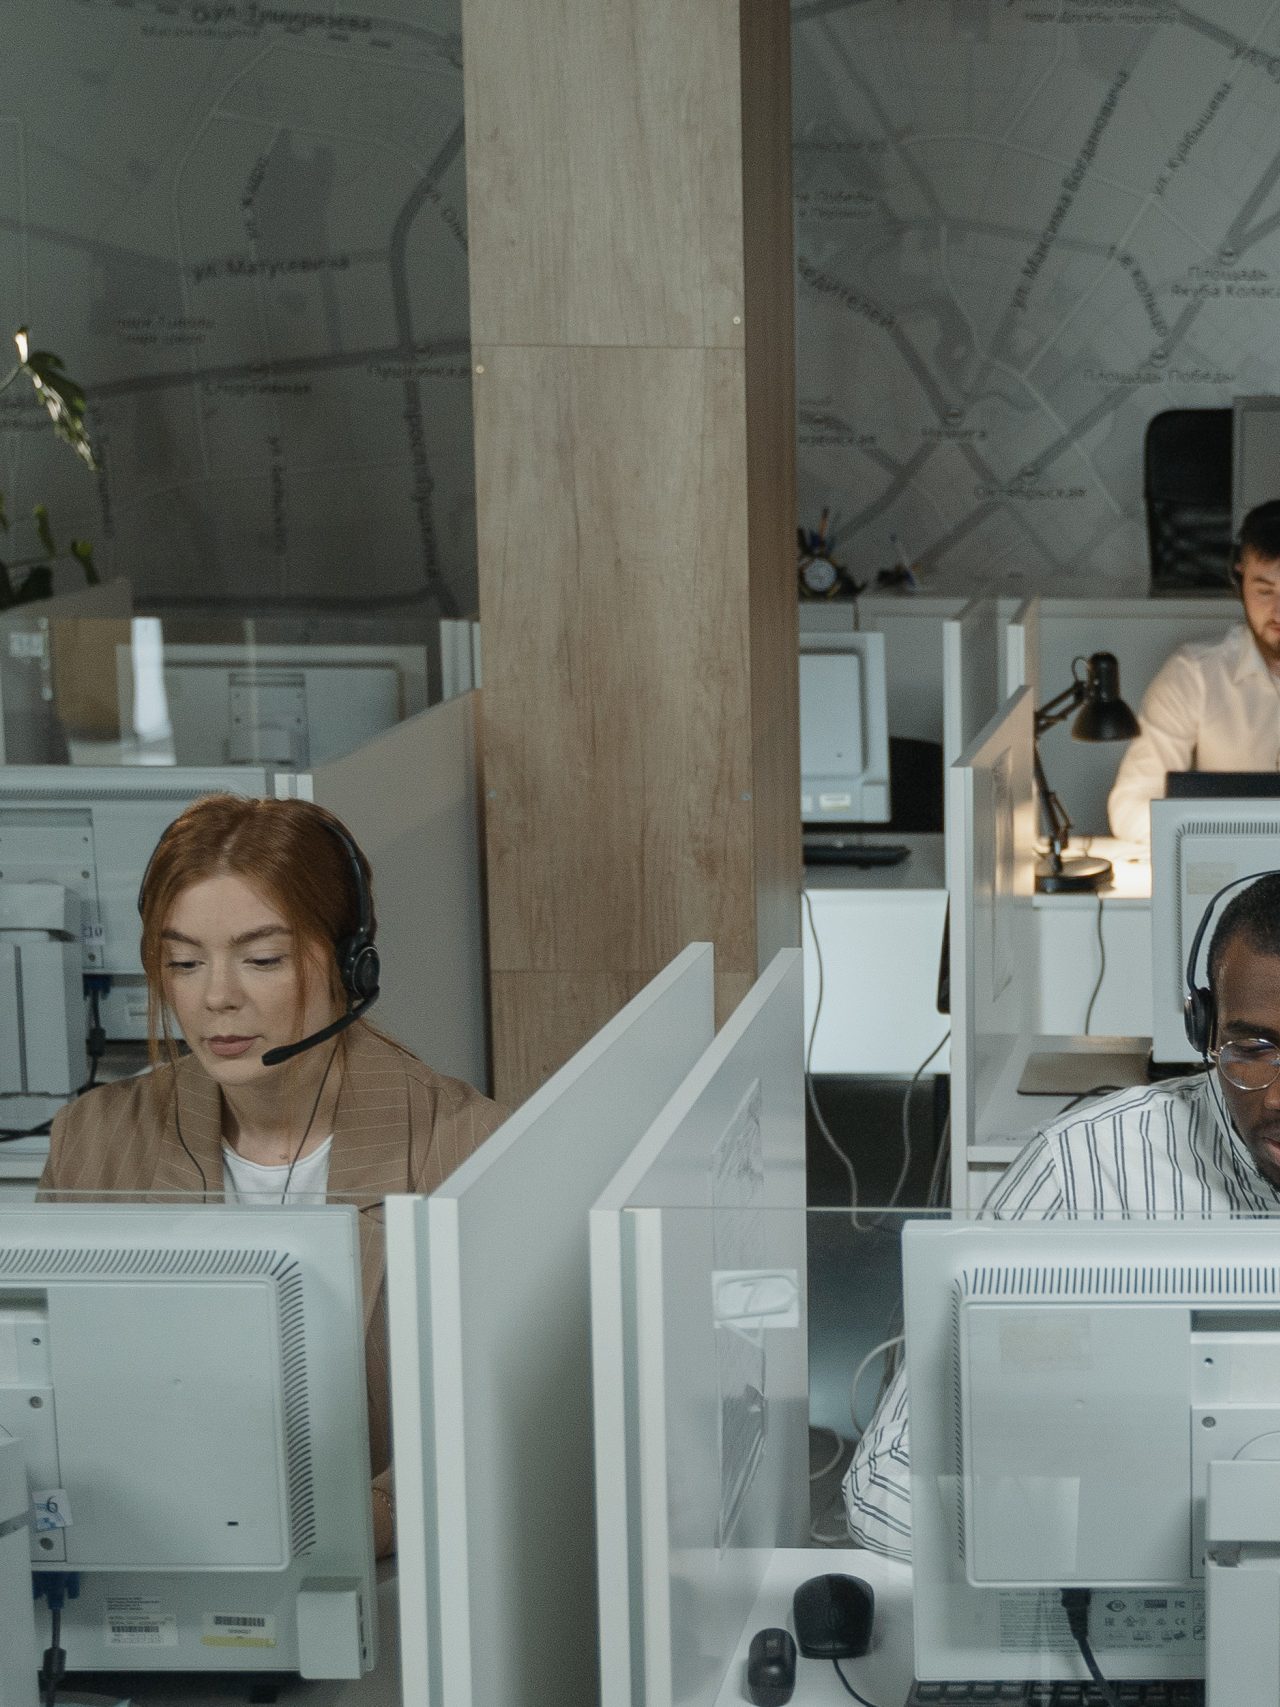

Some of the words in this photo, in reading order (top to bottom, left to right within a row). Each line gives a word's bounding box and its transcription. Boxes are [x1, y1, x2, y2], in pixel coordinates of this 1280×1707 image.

[1019, 195, 1073, 284] Максима
[1060, 70, 1131, 198] Богдановича
[226, 253, 350, 280] Матусевича
[1187, 265, 1268, 282] Площадь
[1170, 283, 1220, 298] Якуба
[1084, 368, 1160, 385] Площадь
[1170, 368, 1237, 385] Победы
[46, 1495, 59, 1514] 6
